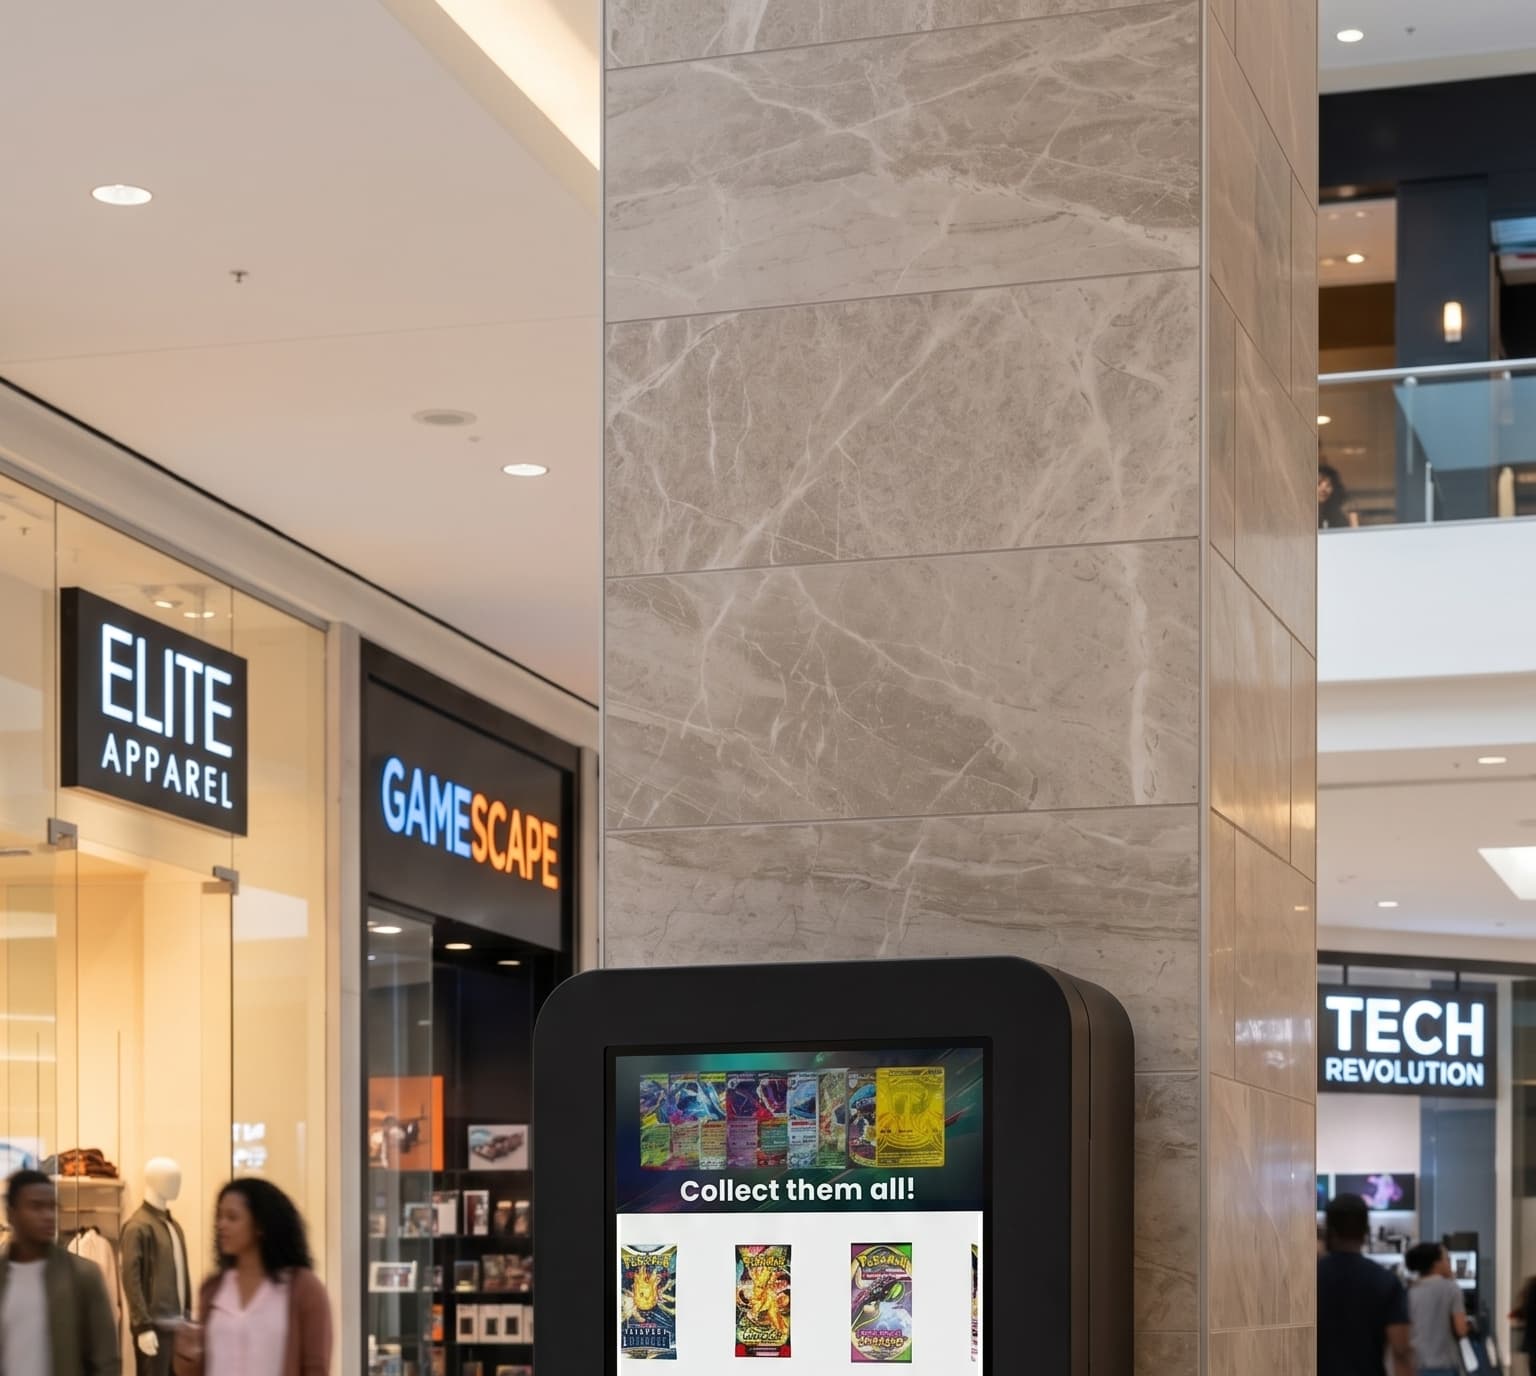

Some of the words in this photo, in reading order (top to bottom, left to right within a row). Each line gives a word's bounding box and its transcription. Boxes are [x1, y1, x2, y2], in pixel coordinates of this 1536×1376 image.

[101, 622, 233, 758] ELITE
[101, 731, 233, 810] APPAREL
[380, 756, 560, 890] GAMESCAPE
[1325, 995, 1485, 1057] TECH
[1325, 1057, 1485, 1087] REVOLUTION
[680, 1179, 780, 1202] Collect
[786, 1178, 862, 1201] them
[870, 1177, 914, 1200] all!
